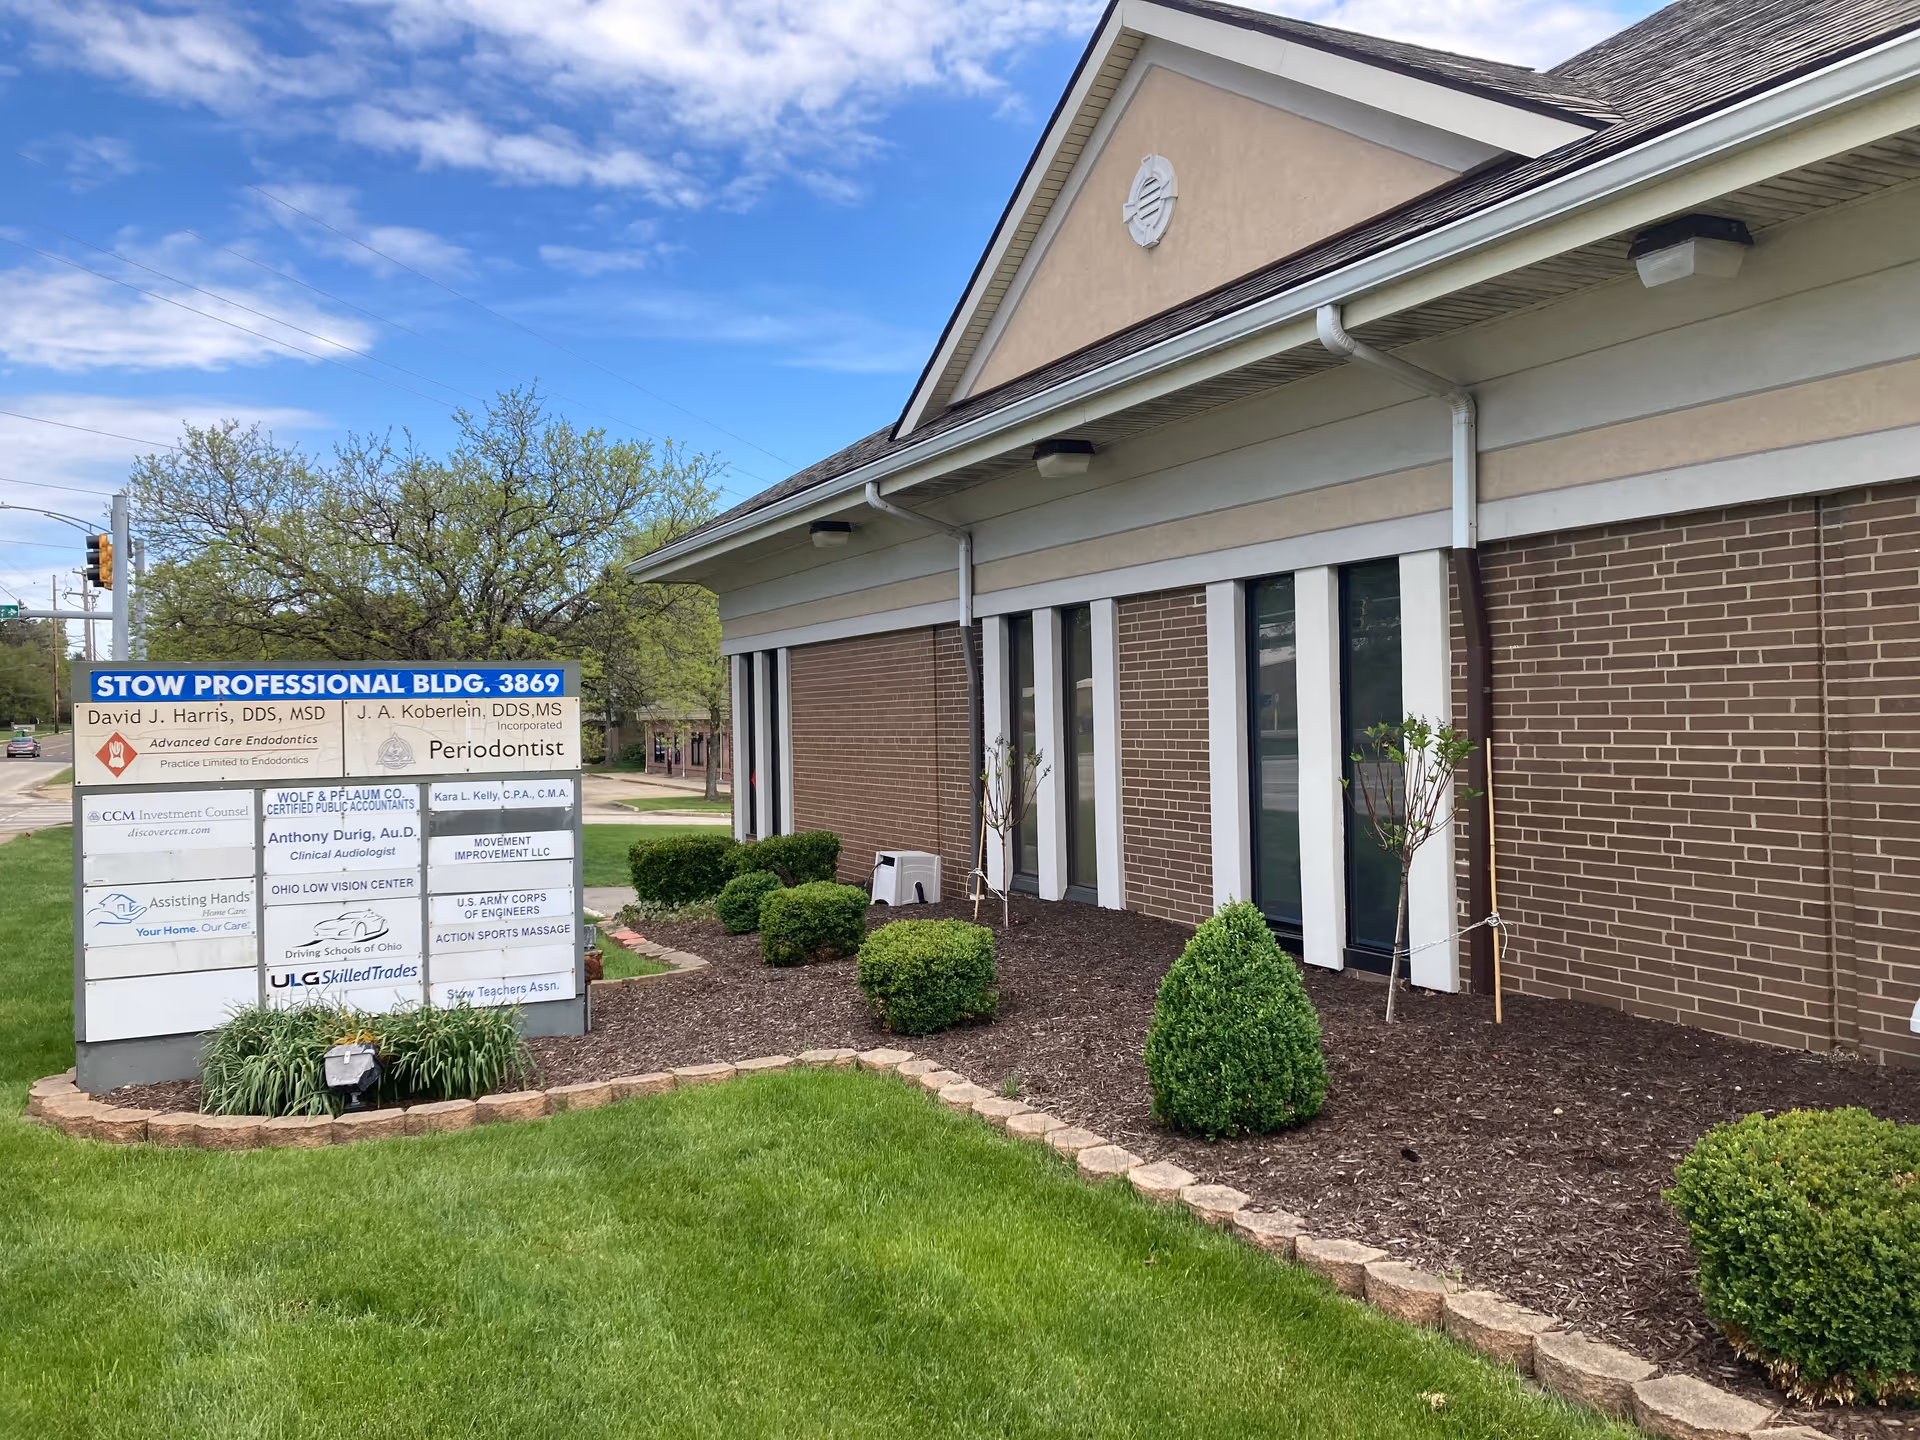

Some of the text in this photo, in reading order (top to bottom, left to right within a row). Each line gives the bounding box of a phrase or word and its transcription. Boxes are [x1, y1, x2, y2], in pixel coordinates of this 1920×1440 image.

[97, 672, 560, 697] STOW PROFESSIONAL BLDG. 3869
[88, 706, 325, 725] David J. Harris, DDS, MSD
[357, 705, 372, 720] J.
[377, 705, 395, 718] A.
[402, 703, 486, 719] Koberlein,
[498, 721, 562, 731] Incorporated
[150, 734, 318, 748] Advanced Care Endodontics
[430, 739, 564, 759] Periodontist
[160, 756, 309, 768] Practice Limited to Endodontics
[277, 789, 405, 803] WOLF & PFLAUM CO.
[434, 792, 458, 802] Kara
[461, 792, 470, 800] L.
[473, 791, 500, 801] Kelly,
[102, 806, 248, 822] CCM Investment Counsel
[267, 799, 415, 815] CERTIFIED PUBLIC ACCOUNTANTS
[128, 827, 210, 838] discoverccm.com
[268, 826, 417, 844] Anthony Durig, Au.D.
[474, 836, 531, 847] MOVEMENT
[290, 847, 396, 861] Clinical Audiologist
[455, 848, 550, 860] IMPROVEMENT LLC
[272, 879, 413, 895] OHIO LOW VISION CENTER
[150, 892, 250, 908] Assisting Hands
[457, 893, 546, 907] U.S. ARMY CORPS
[202, 908, 246, 917] Home Care
[465, 906, 540, 919] OF ENGINEERS
[136, 928, 161, 937] Your
[163, 926, 198, 935] Home.
[202, 923, 222, 932] Our
[436, 924, 570, 943] ACTION SPORTS MASSAGE
[285, 943, 402, 959] Driving Schools of Ohio
[478, 985, 526, 997] Teachers
[530, 982, 559, 992] Assn.
